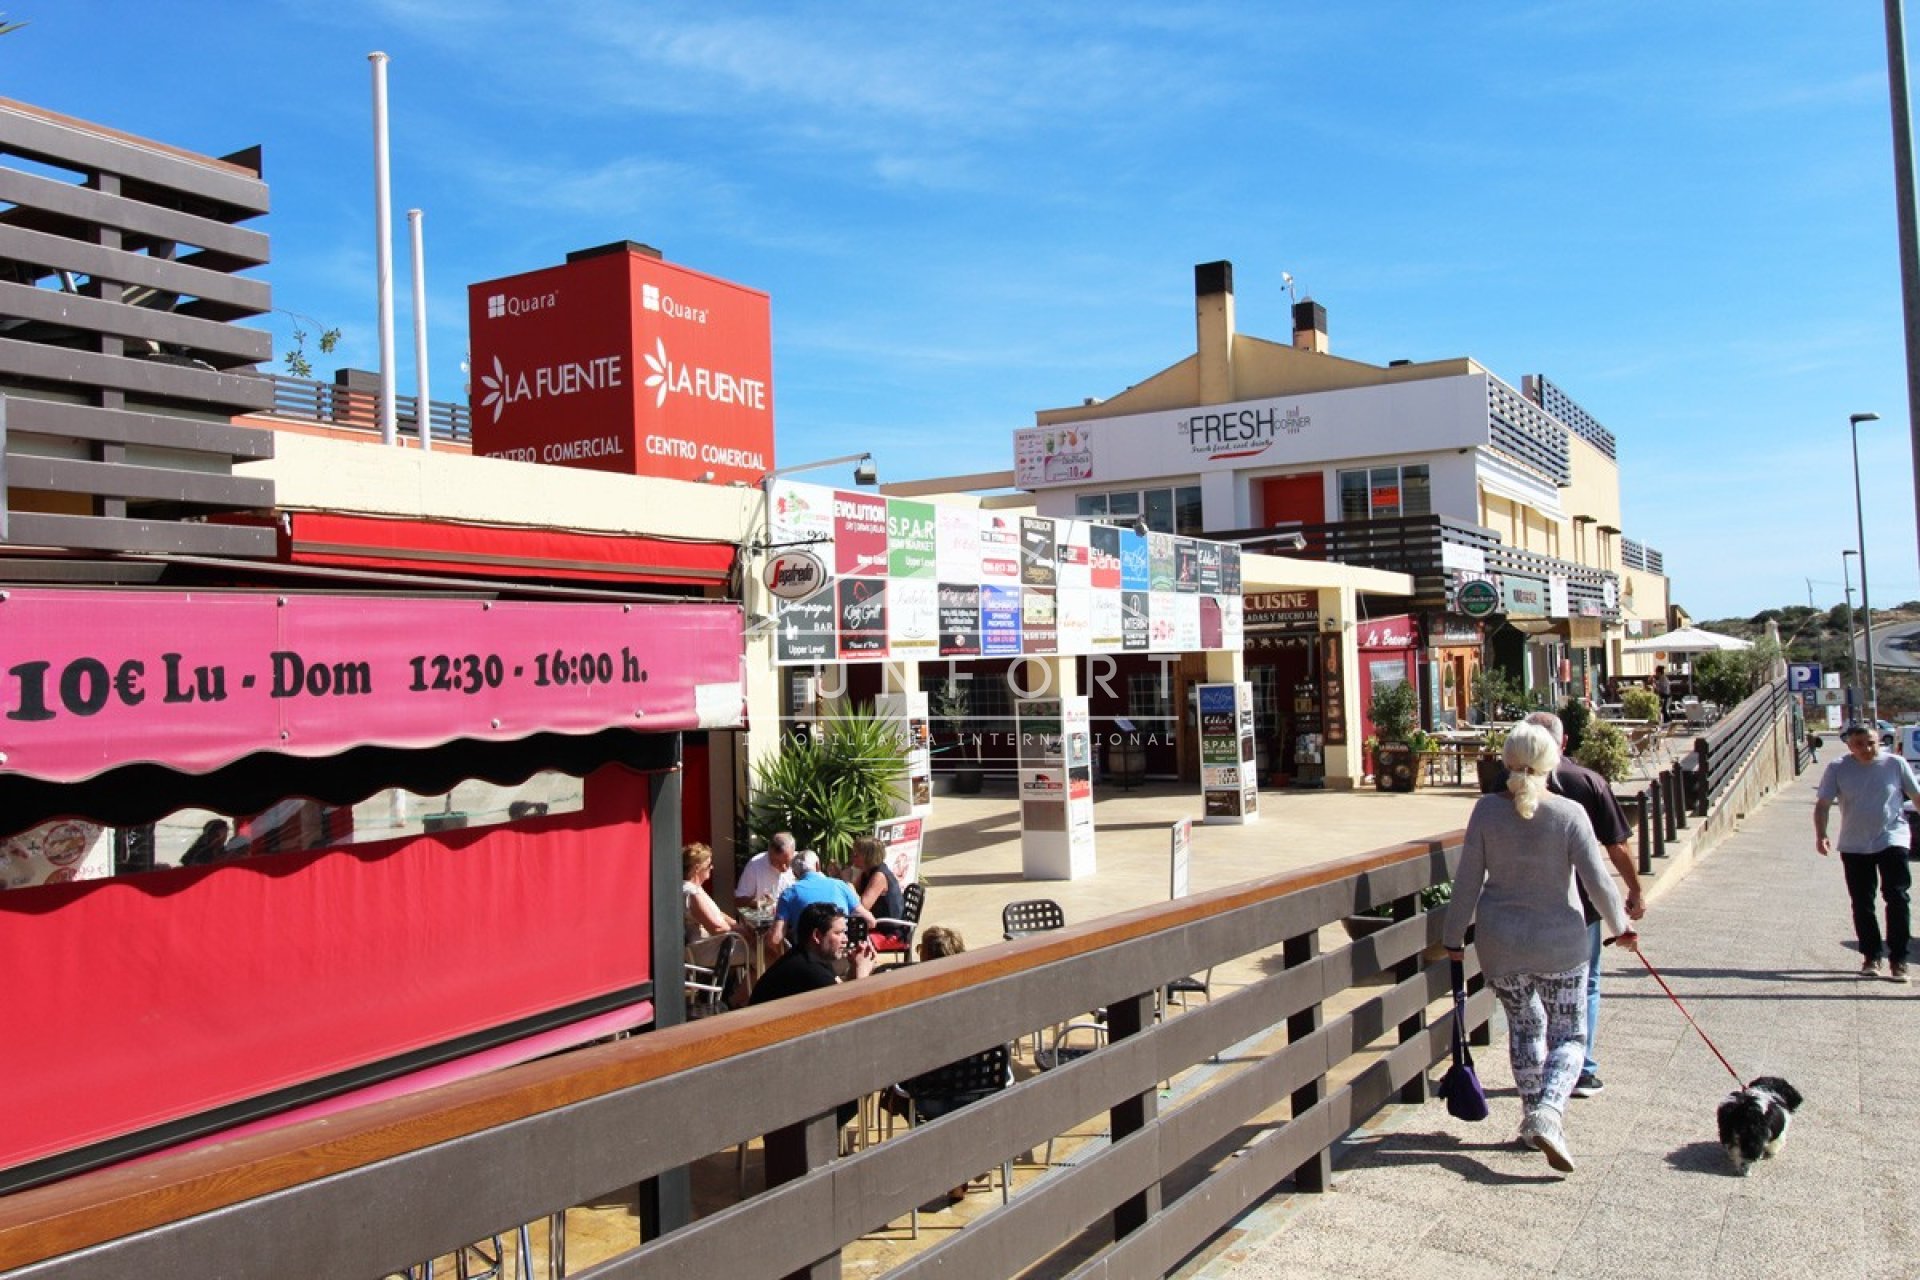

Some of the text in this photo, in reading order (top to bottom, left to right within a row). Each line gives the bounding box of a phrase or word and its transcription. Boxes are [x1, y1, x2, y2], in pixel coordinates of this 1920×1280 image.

[508, 294, 555, 315] Quara
[662, 296, 706, 323] Quara
[505, 355, 621, 403] LA FUENTE
[667, 361, 765, 410] LA FUENTE
[1190, 408, 1274, 445] FRESH
[544, 435, 624, 462] COMERCIAL
[646, 434, 766, 470] CENTRO COMERCIAL
[834, 500, 886, 523] EVOLUTION
[1243, 592, 1309, 610] CUISINE
[814, 622, 833, 632] BAR
[788, 644, 826, 656] Upper Level
[6, 656, 145, 721] 10€
[161, 653, 227, 703] Lu
[270, 651, 372, 698] Dom
[409, 653, 504, 694] 12:30
[533, 648, 613, 687] 16:00
[621, 647, 648, 683] h.
[1791, 666, 1811, 690] P
